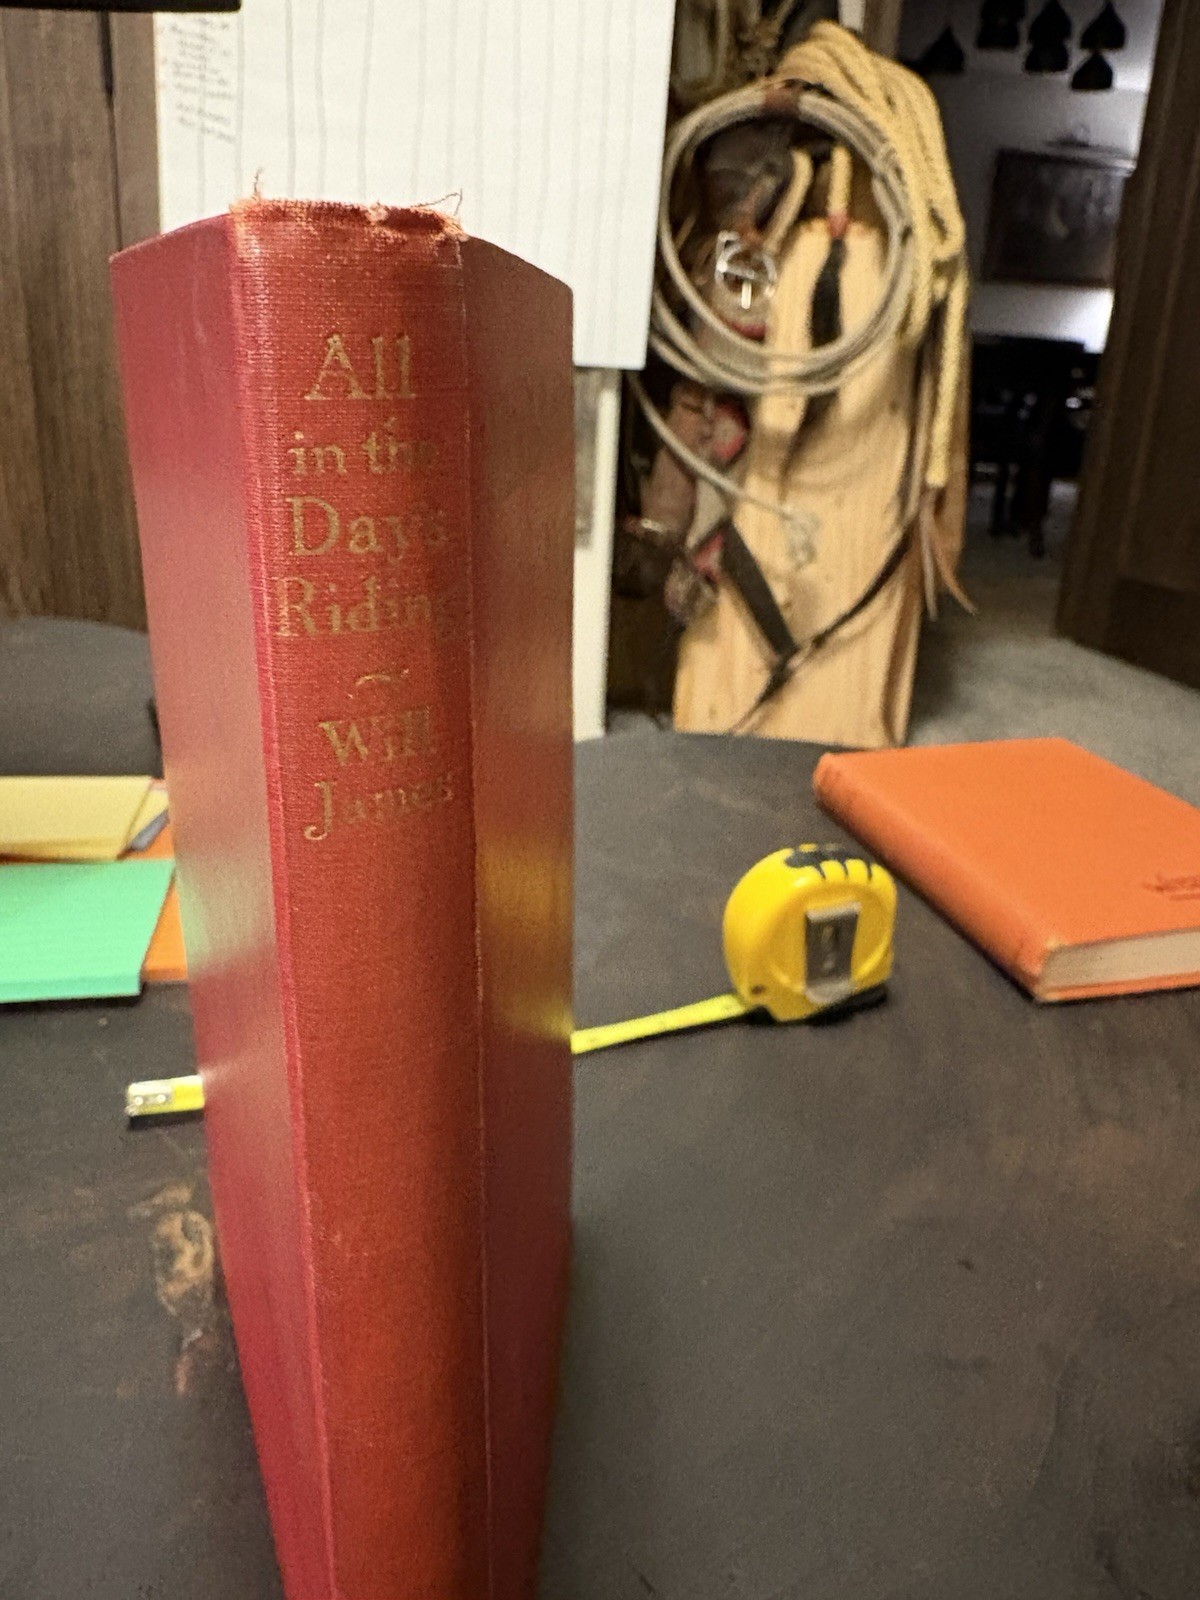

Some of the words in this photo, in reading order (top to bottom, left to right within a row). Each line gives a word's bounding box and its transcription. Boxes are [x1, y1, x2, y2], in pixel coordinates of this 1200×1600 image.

[304, 333, 416, 400] All
[288, 430, 347, 475] in
[271, 575, 460, 642] Ridin
